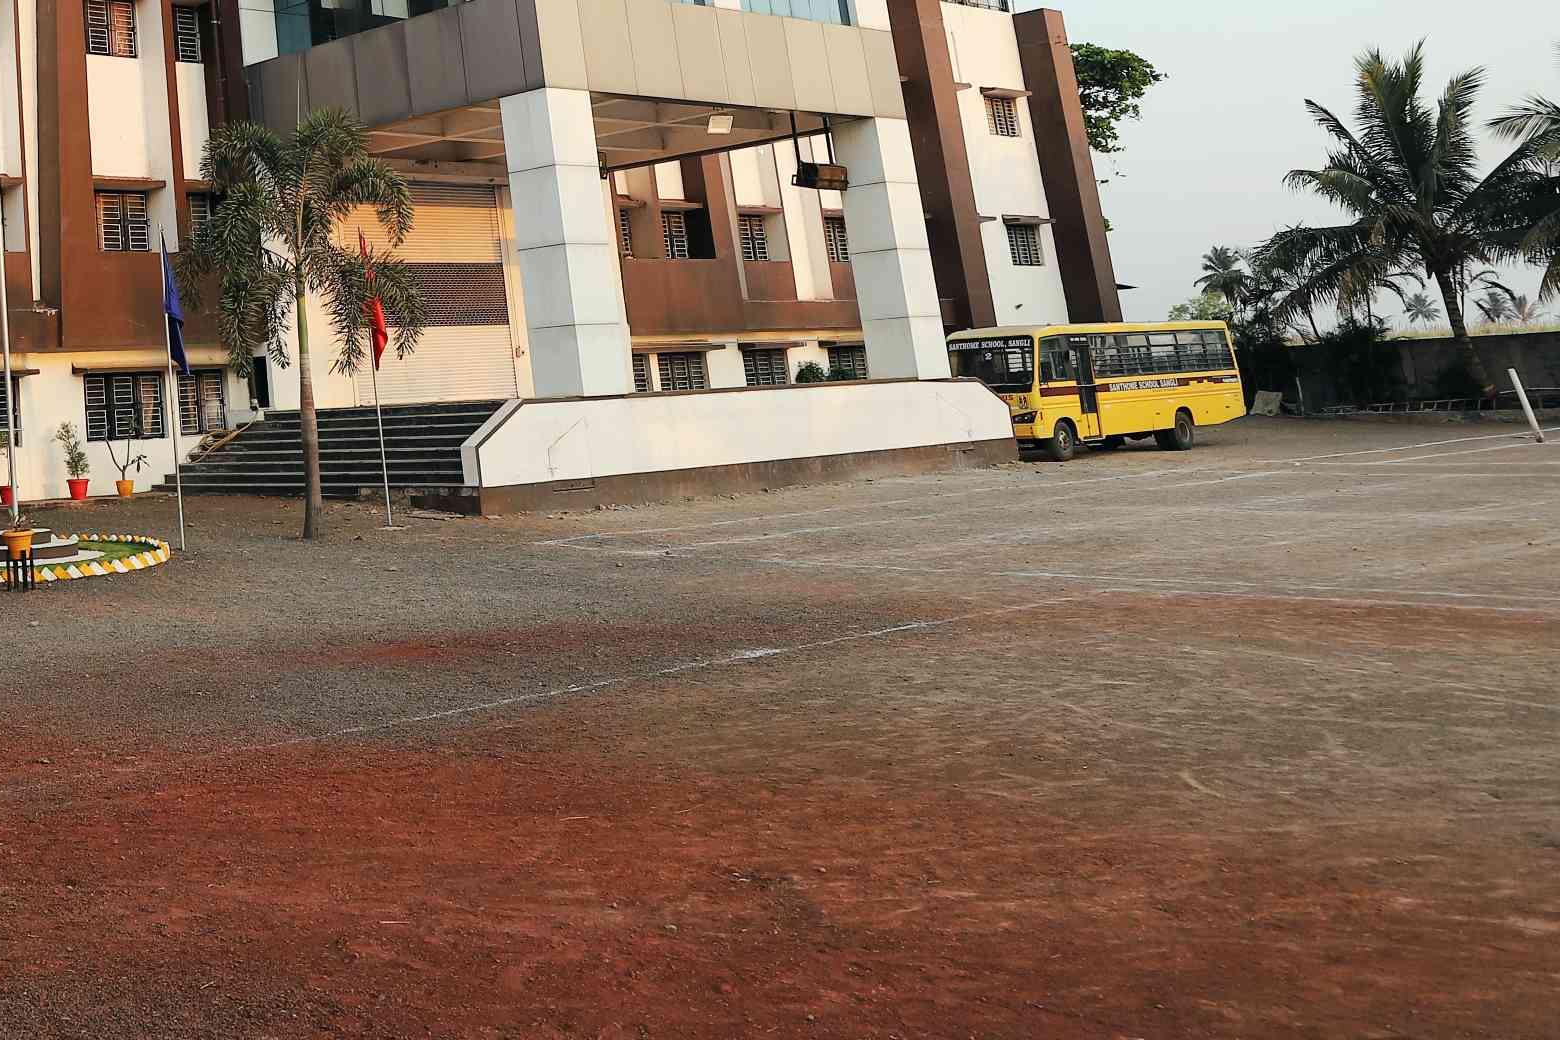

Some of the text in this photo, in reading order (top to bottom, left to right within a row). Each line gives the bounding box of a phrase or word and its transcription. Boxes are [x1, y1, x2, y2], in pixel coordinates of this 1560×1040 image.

[948, 342, 979, 351] SANTHOME
[1008, 339, 1031, 347] SANGLI
[985, 352, 993, 360] 2
[1109, 378, 1178, 392] SANTHOME SCHOOL SANGLI
